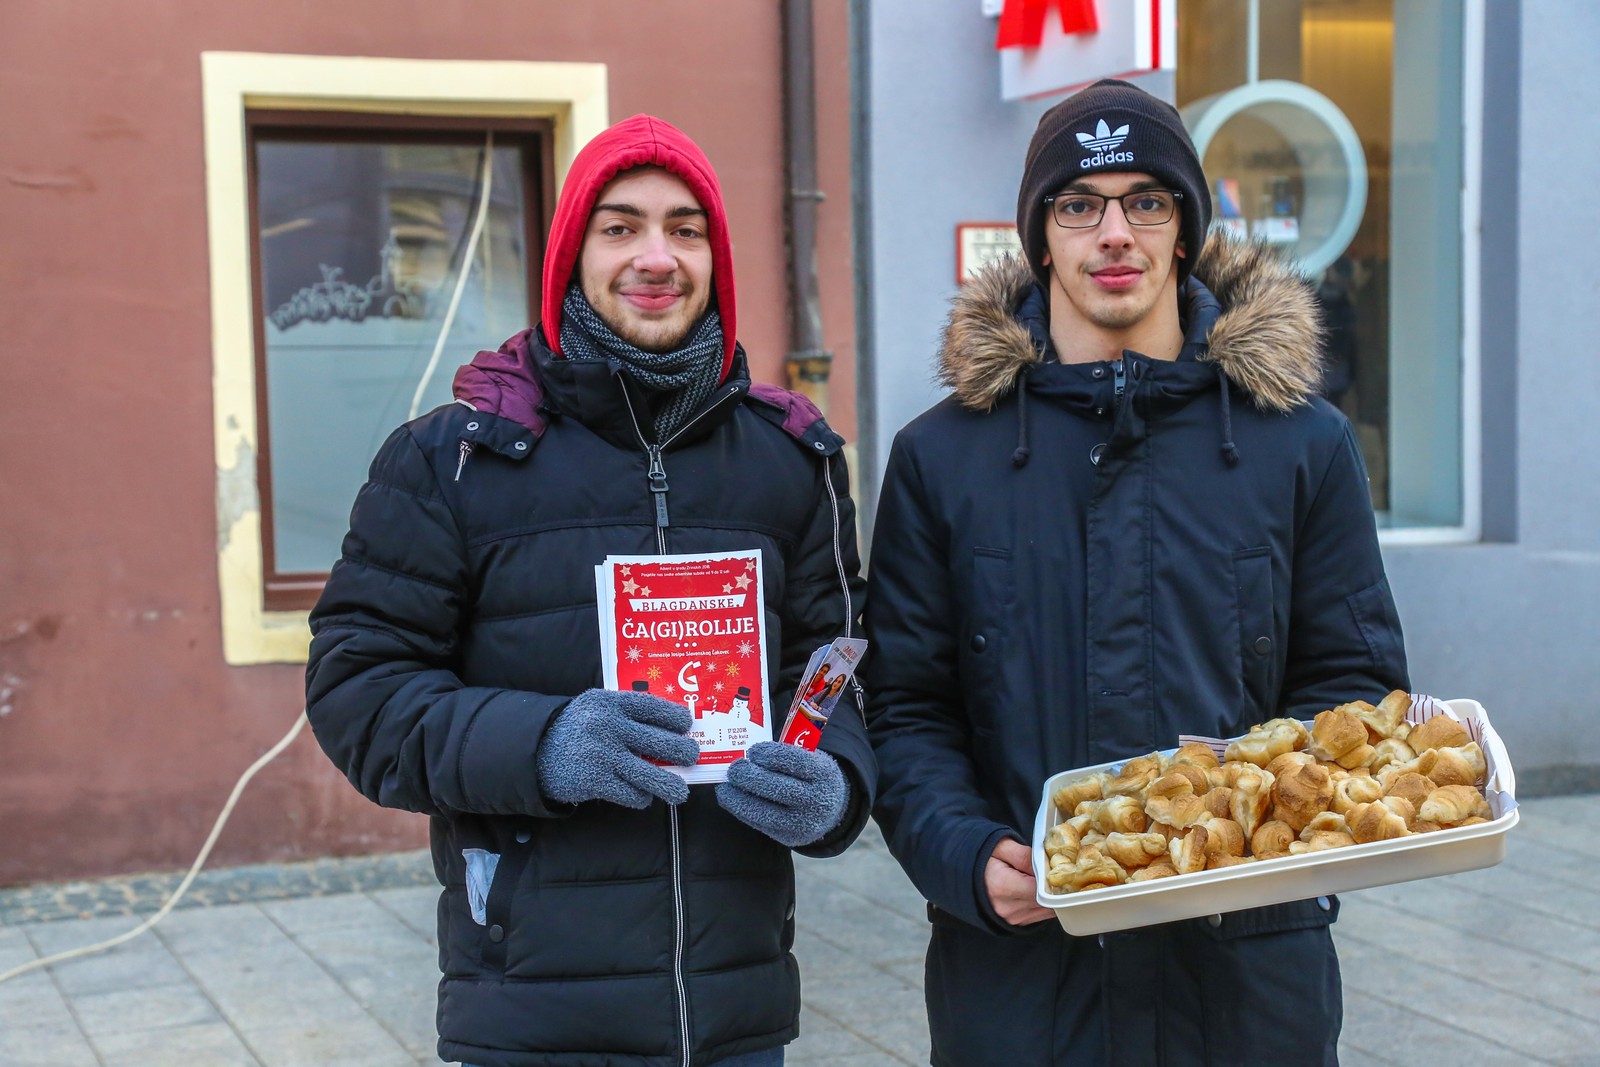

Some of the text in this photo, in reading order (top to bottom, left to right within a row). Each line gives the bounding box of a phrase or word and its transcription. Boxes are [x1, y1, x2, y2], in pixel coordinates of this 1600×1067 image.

[1080, 150, 1134, 168] adidas
[642, 598, 735, 612] BLAGDANSKE
[621, 617, 755, 641] ČA(GI)ROLIJE
